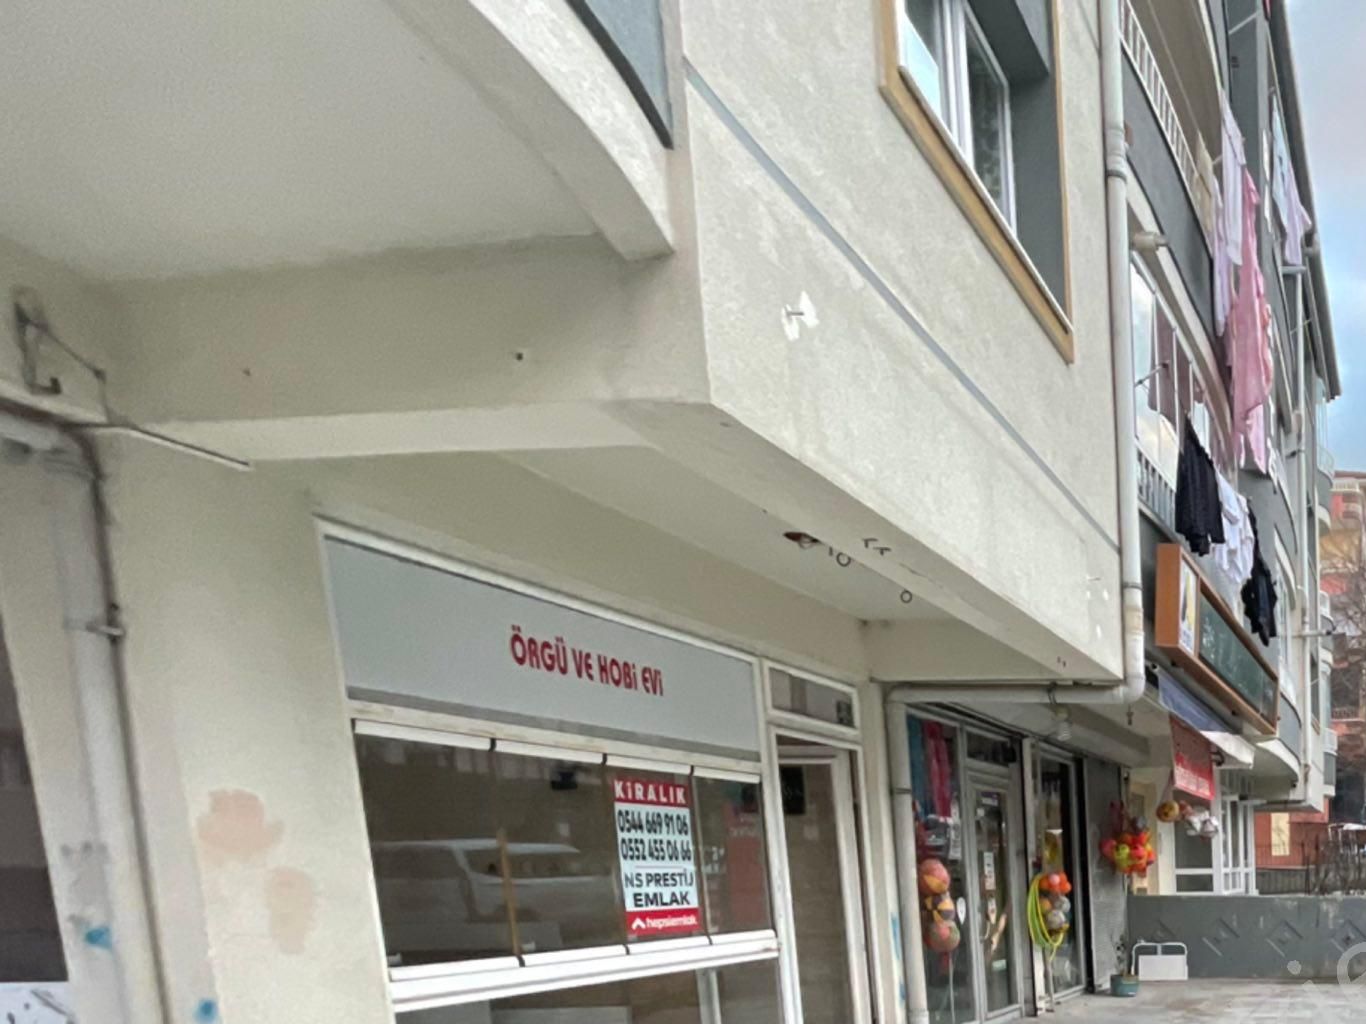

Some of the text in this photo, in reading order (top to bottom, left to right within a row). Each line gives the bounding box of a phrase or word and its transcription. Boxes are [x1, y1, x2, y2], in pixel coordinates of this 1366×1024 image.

[510, 624, 568, 675] ÖRGÜ
[571, 647, 594, 681] VE
[613, 779, 686, 804] KİRALIK
[617, 810, 688, 836] 0544 669 91 06
[621, 838, 646, 860] 0552
[648, 838, 665, 860] 455
[667, 839, 679, 860] 06
[624, 868, 694, 888] NS PRESTİJ
[633, 891, 691, 908] EMLAK
